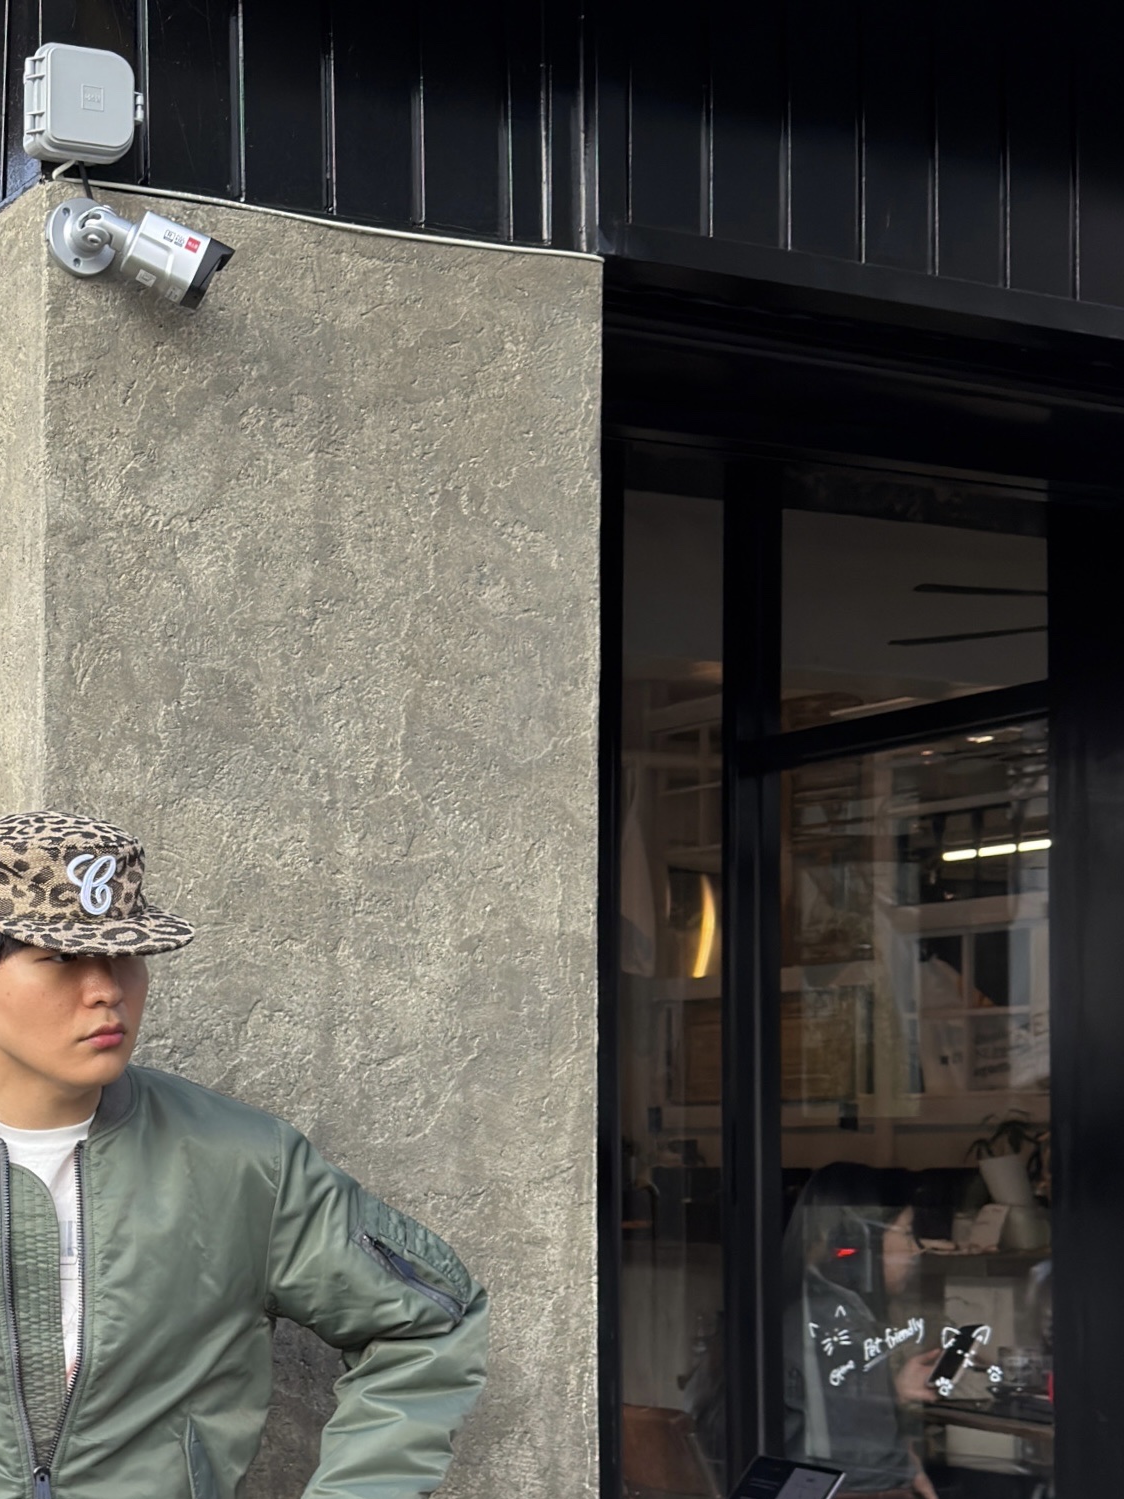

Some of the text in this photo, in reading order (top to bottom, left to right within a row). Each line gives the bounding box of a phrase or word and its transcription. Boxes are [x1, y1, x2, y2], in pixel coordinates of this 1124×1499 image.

[66, 853, 117, 916] C
[863, 1317, 925, 1361] Pet friendly
